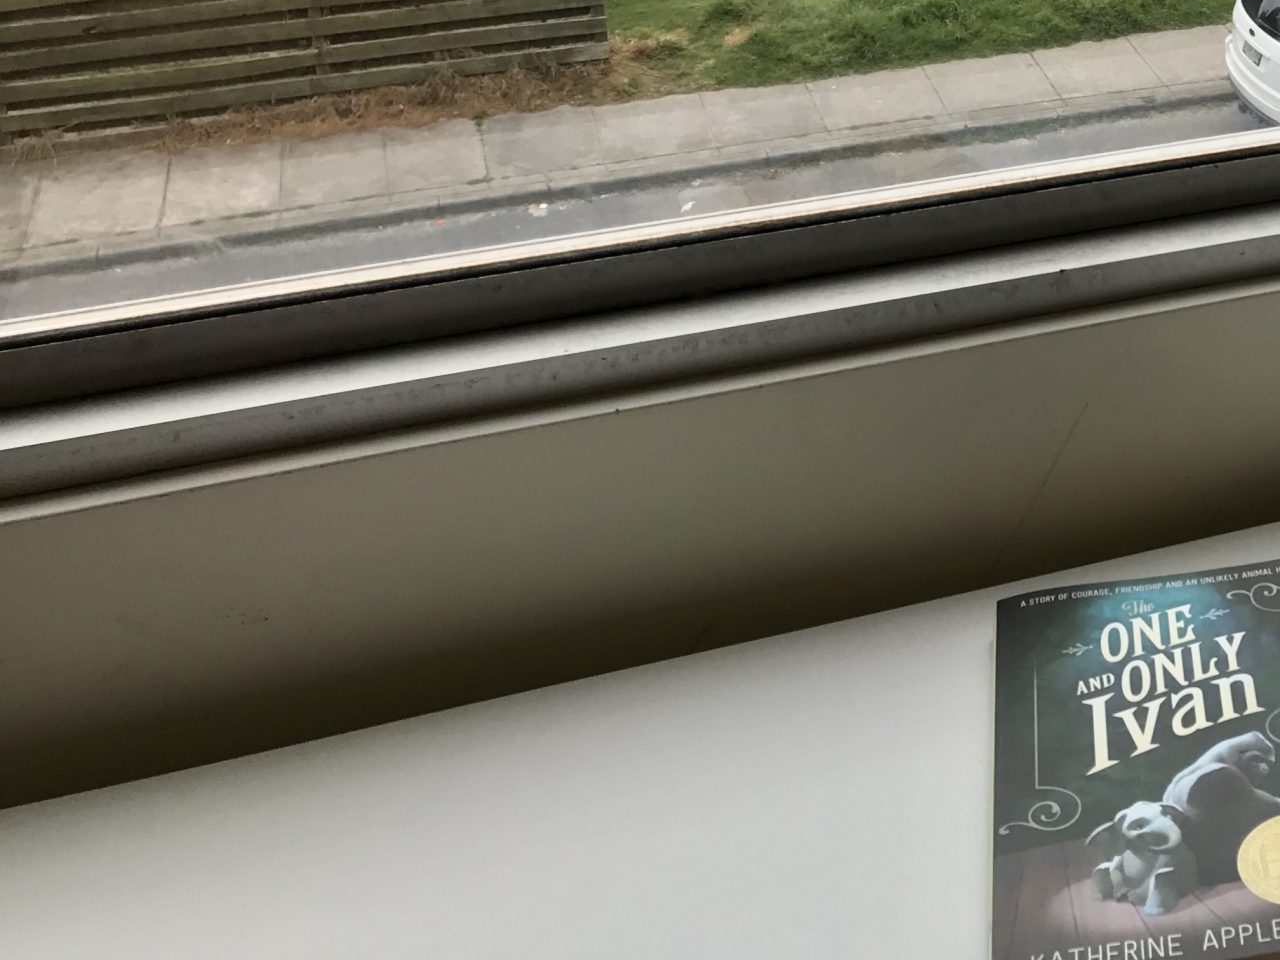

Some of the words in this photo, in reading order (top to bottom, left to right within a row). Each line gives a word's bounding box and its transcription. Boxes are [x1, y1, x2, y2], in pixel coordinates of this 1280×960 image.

[1020, 600, 1027, 608] A
[1028, 594, 1056, 607] STORY
[1057, 592, 1069, 601] OF
[1071, 587, 1113, 600] COURAGE,
[1115, 582, 1163, 595] FRIENDSHIP
[1165, 581, 1183, 589] AND
[1185, 578, 1198, 587] AN
[1200, 573, 1240, 585] UNLIKELY
[1241, 567, 1273, 579] ANIMAL
[1121, 599, 1156, 617] The
[1100, 603, 1197, 663] ONE
[1076, 672, 1116, 696] AND
[1121, 631, 1247, 703] ONLY
[1081, 672, 1266, 777] Ivan
[1030, 933, 1184, 960] THERINE
